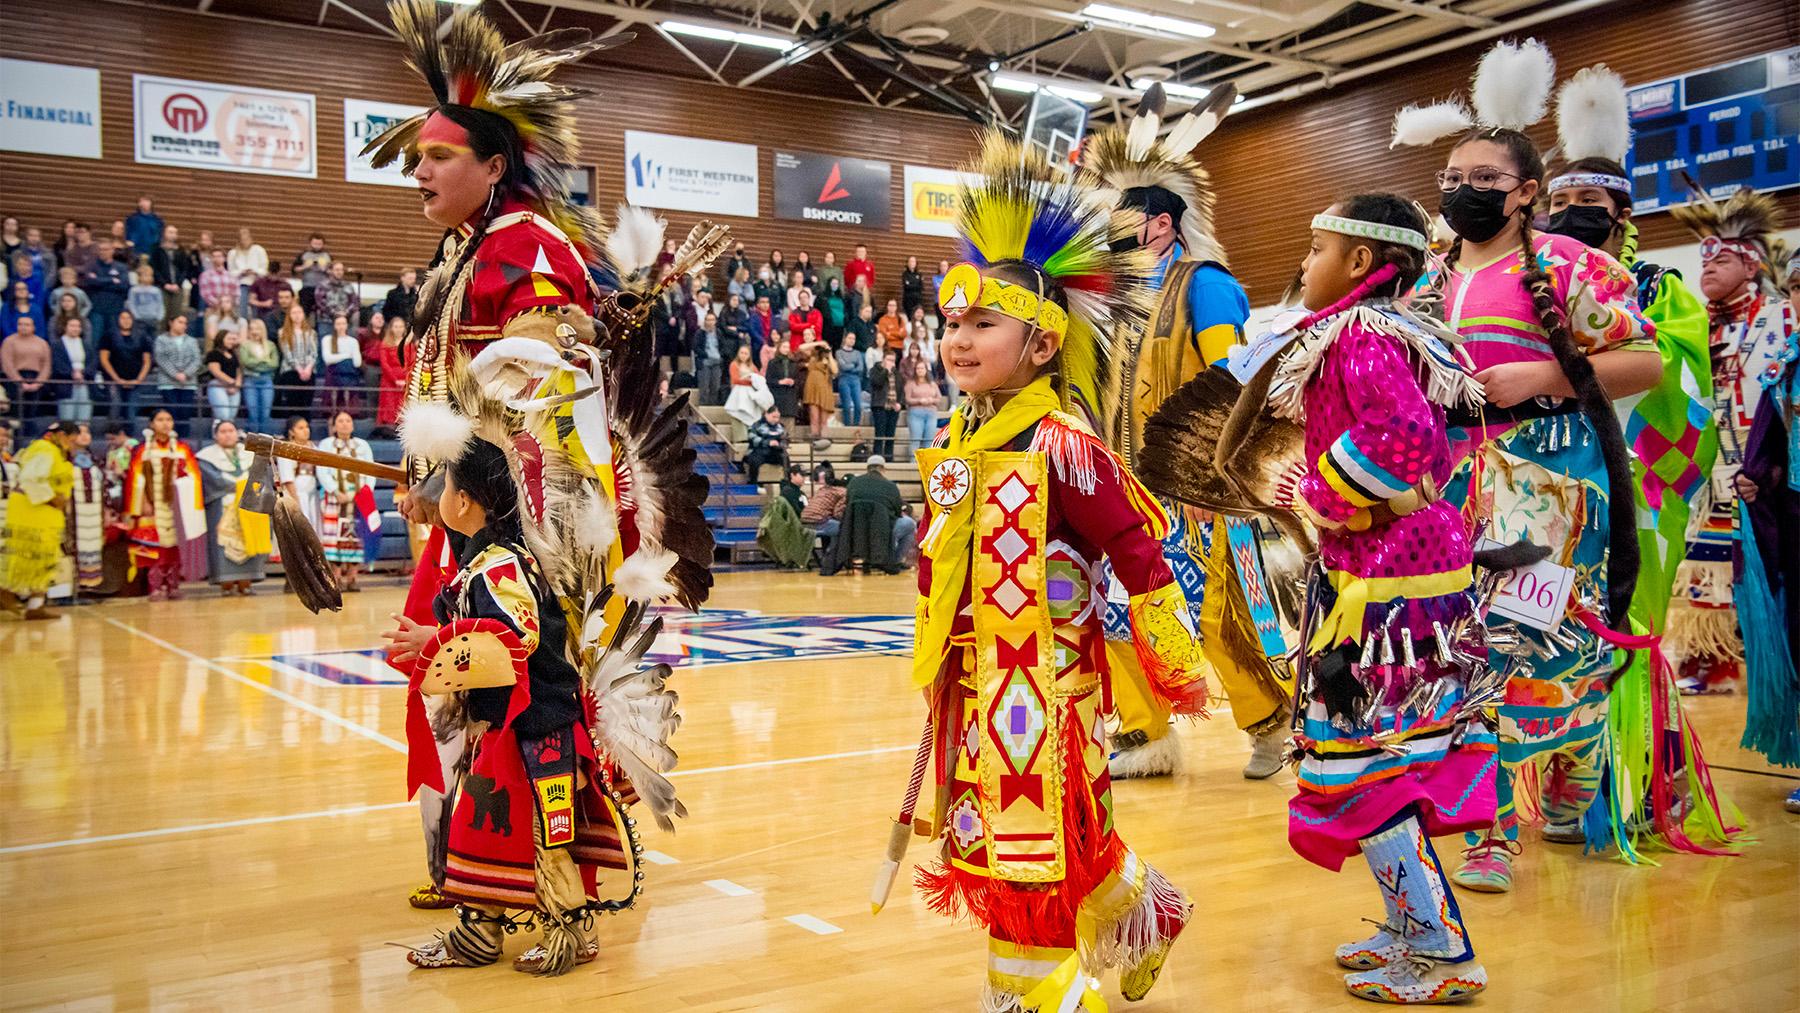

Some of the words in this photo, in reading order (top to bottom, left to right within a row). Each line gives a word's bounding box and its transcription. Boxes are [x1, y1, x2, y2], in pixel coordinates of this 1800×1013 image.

[8, 100, 92, 126] FINANCIAL
[1695, 149, 1730, 165] PLAYER
[1732, 144, 1755, 158] FOUL
[668, 168, 699, 178] FIRST
[703, 171, 754, 184] WESTERN
[1501, 567, 1557, 608] 206
